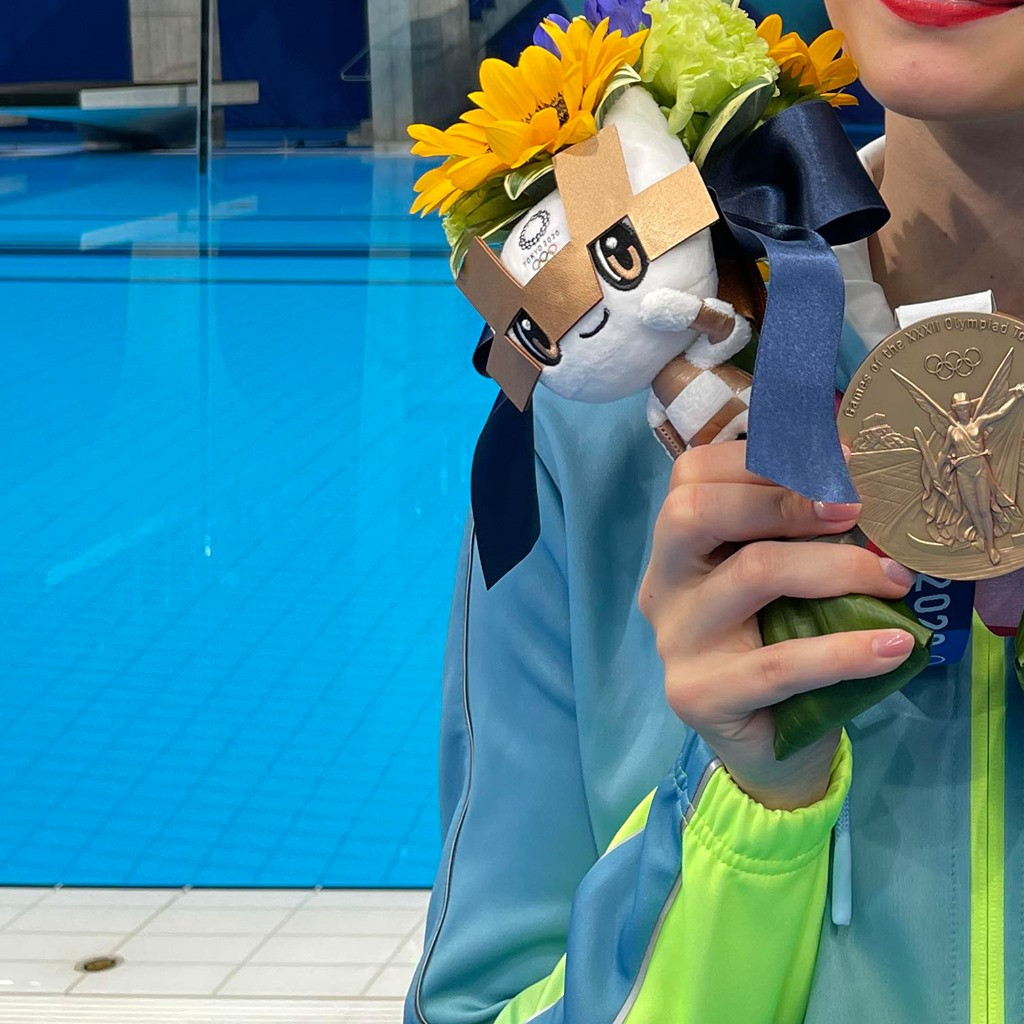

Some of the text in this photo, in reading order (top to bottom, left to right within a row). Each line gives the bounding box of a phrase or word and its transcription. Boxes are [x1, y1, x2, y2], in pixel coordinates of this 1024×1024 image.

[522, 230, 560, 268] TOKYO 2020
[844, 374, 872, 417] Games
[870, 356, 883, 373] of
[881, 340, 905, 359] the
[905, 321, 941, 343] XXXII
[944, 317, 1010, 334] Olympiad
